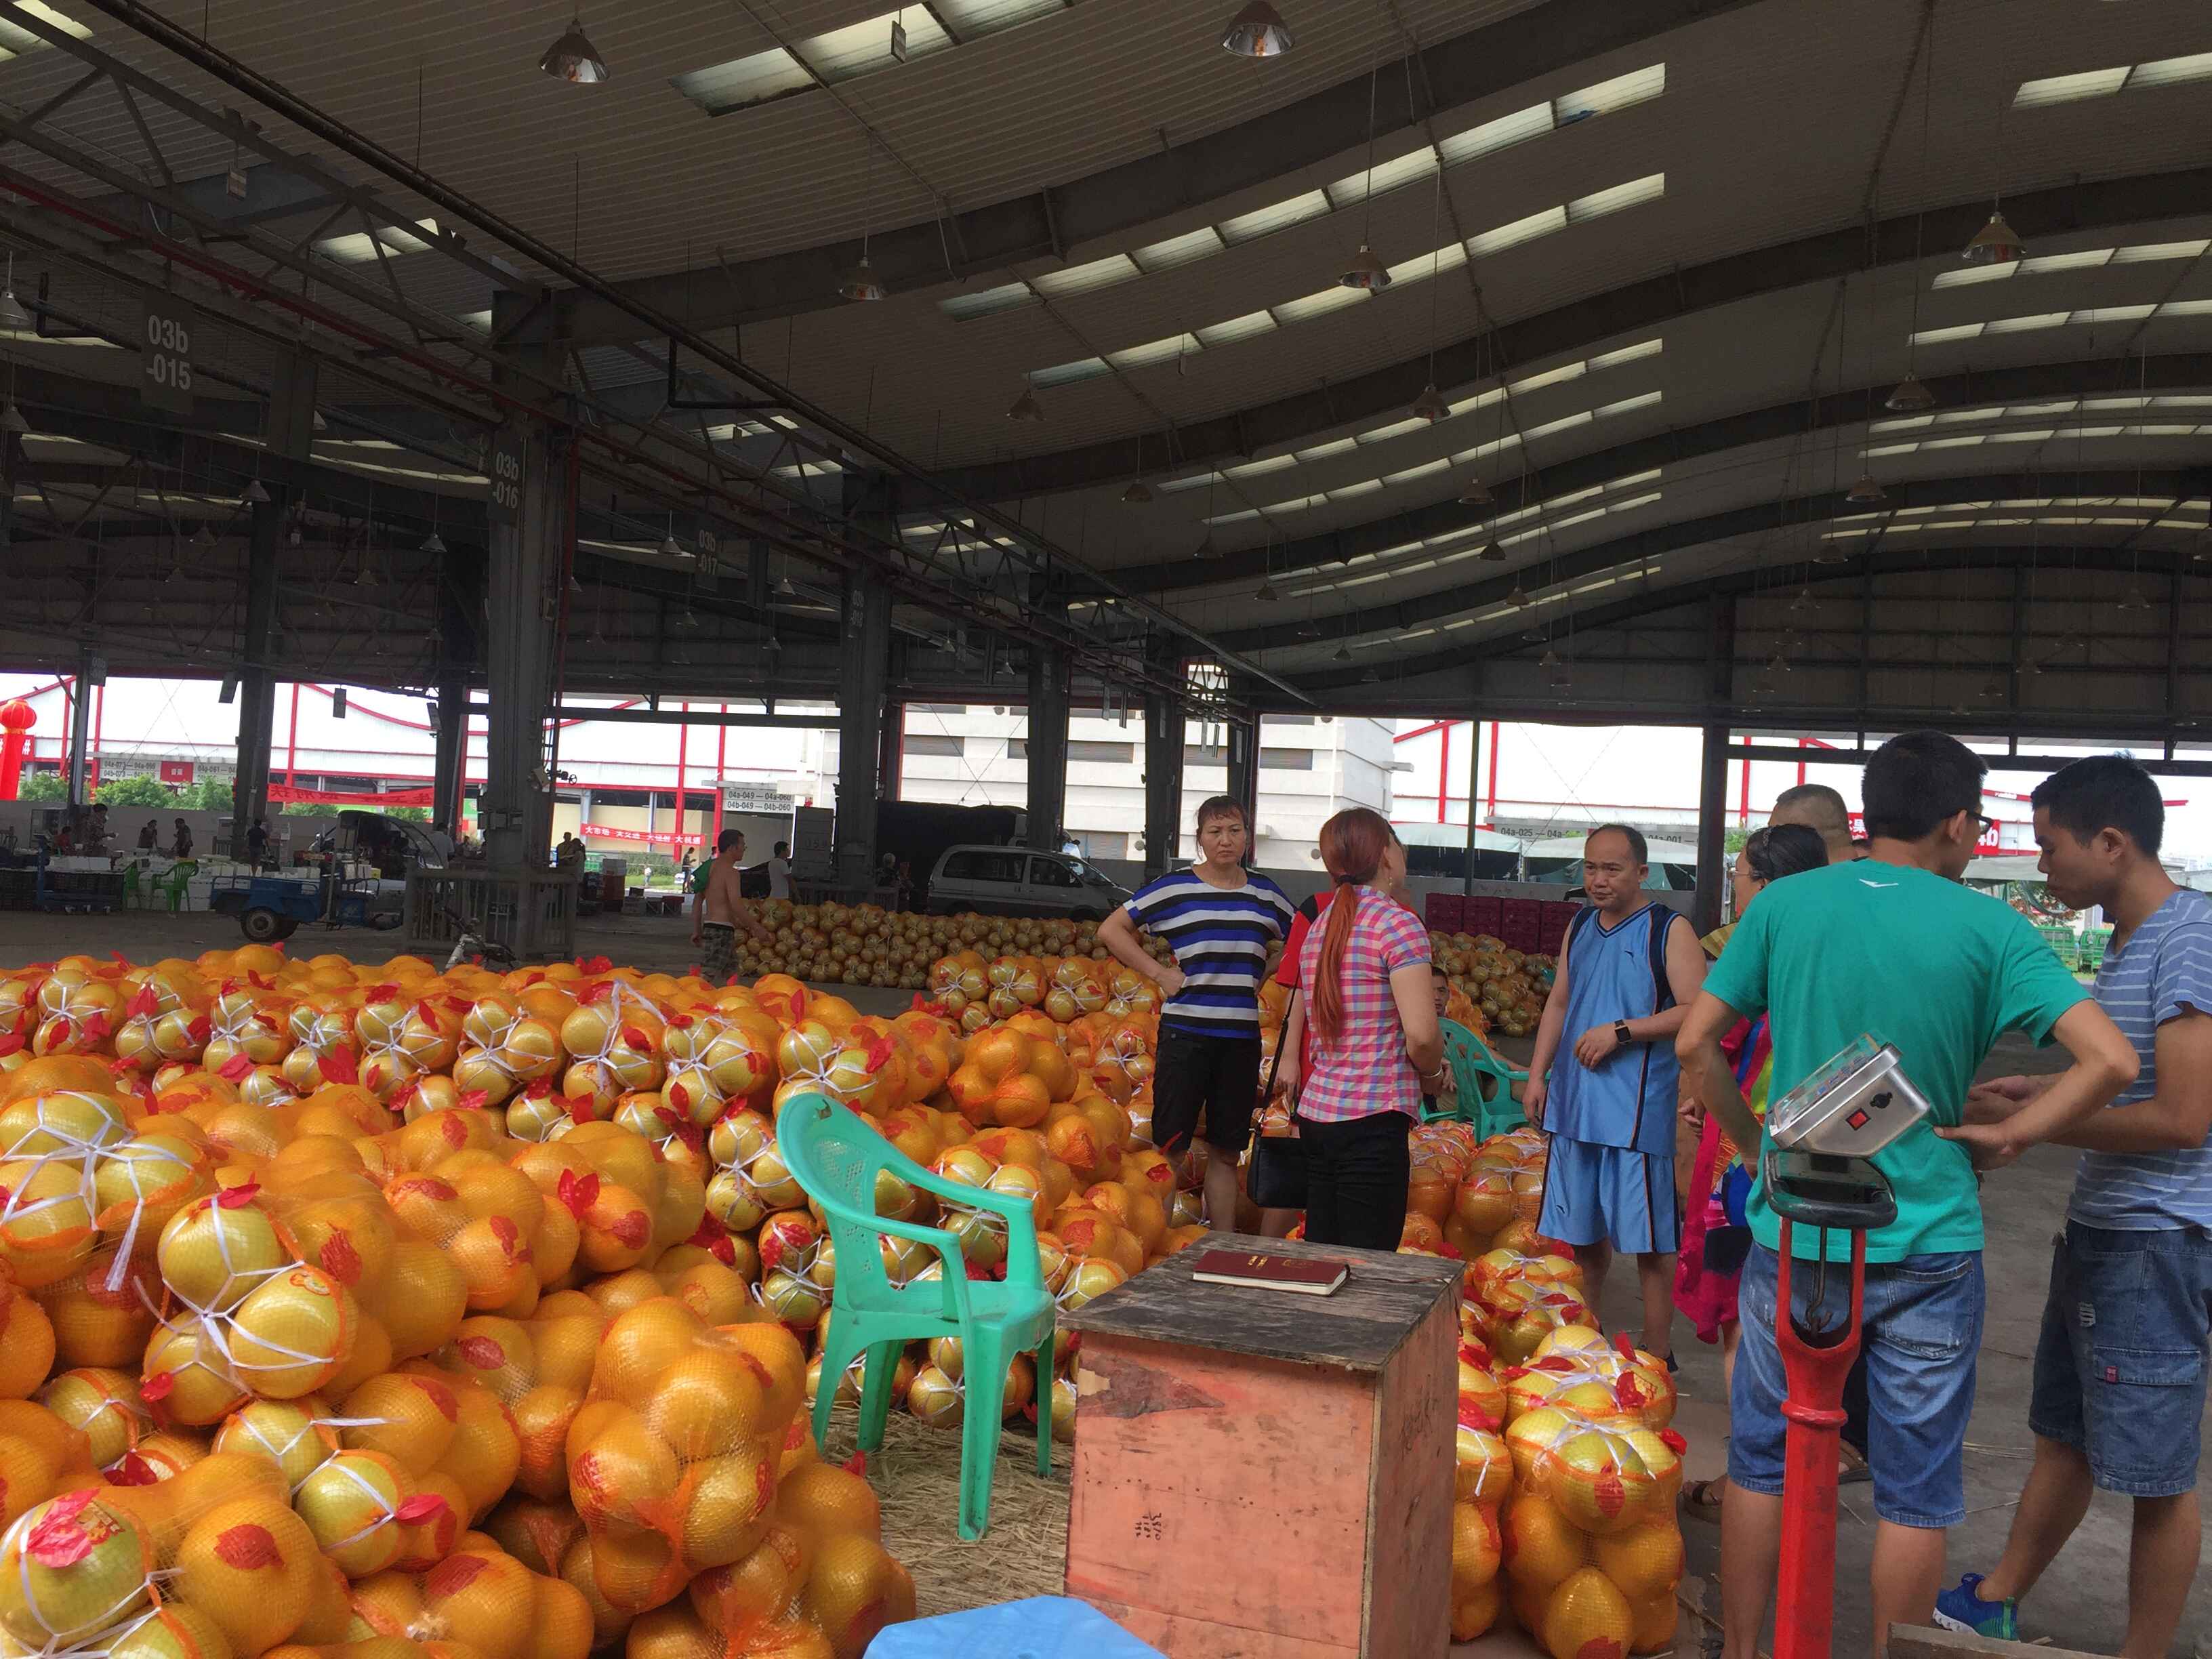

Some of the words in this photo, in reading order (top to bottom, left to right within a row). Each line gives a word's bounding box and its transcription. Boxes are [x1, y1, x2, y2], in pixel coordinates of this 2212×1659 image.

[148, 314, 189, 354] 03b
[146, 353, 191, 390] -015
[496, 451, 519, 481] 03b
[493, 481, 520, 509] -016
[699, 529, 716, 552] 03b
[727, 801, 754, 809] 04b-049
[764, 802, 791, 811] 04b-060
[729, 791, 754, 799] 04a-049
[1500, 827, 1533, 836] 04a-025
